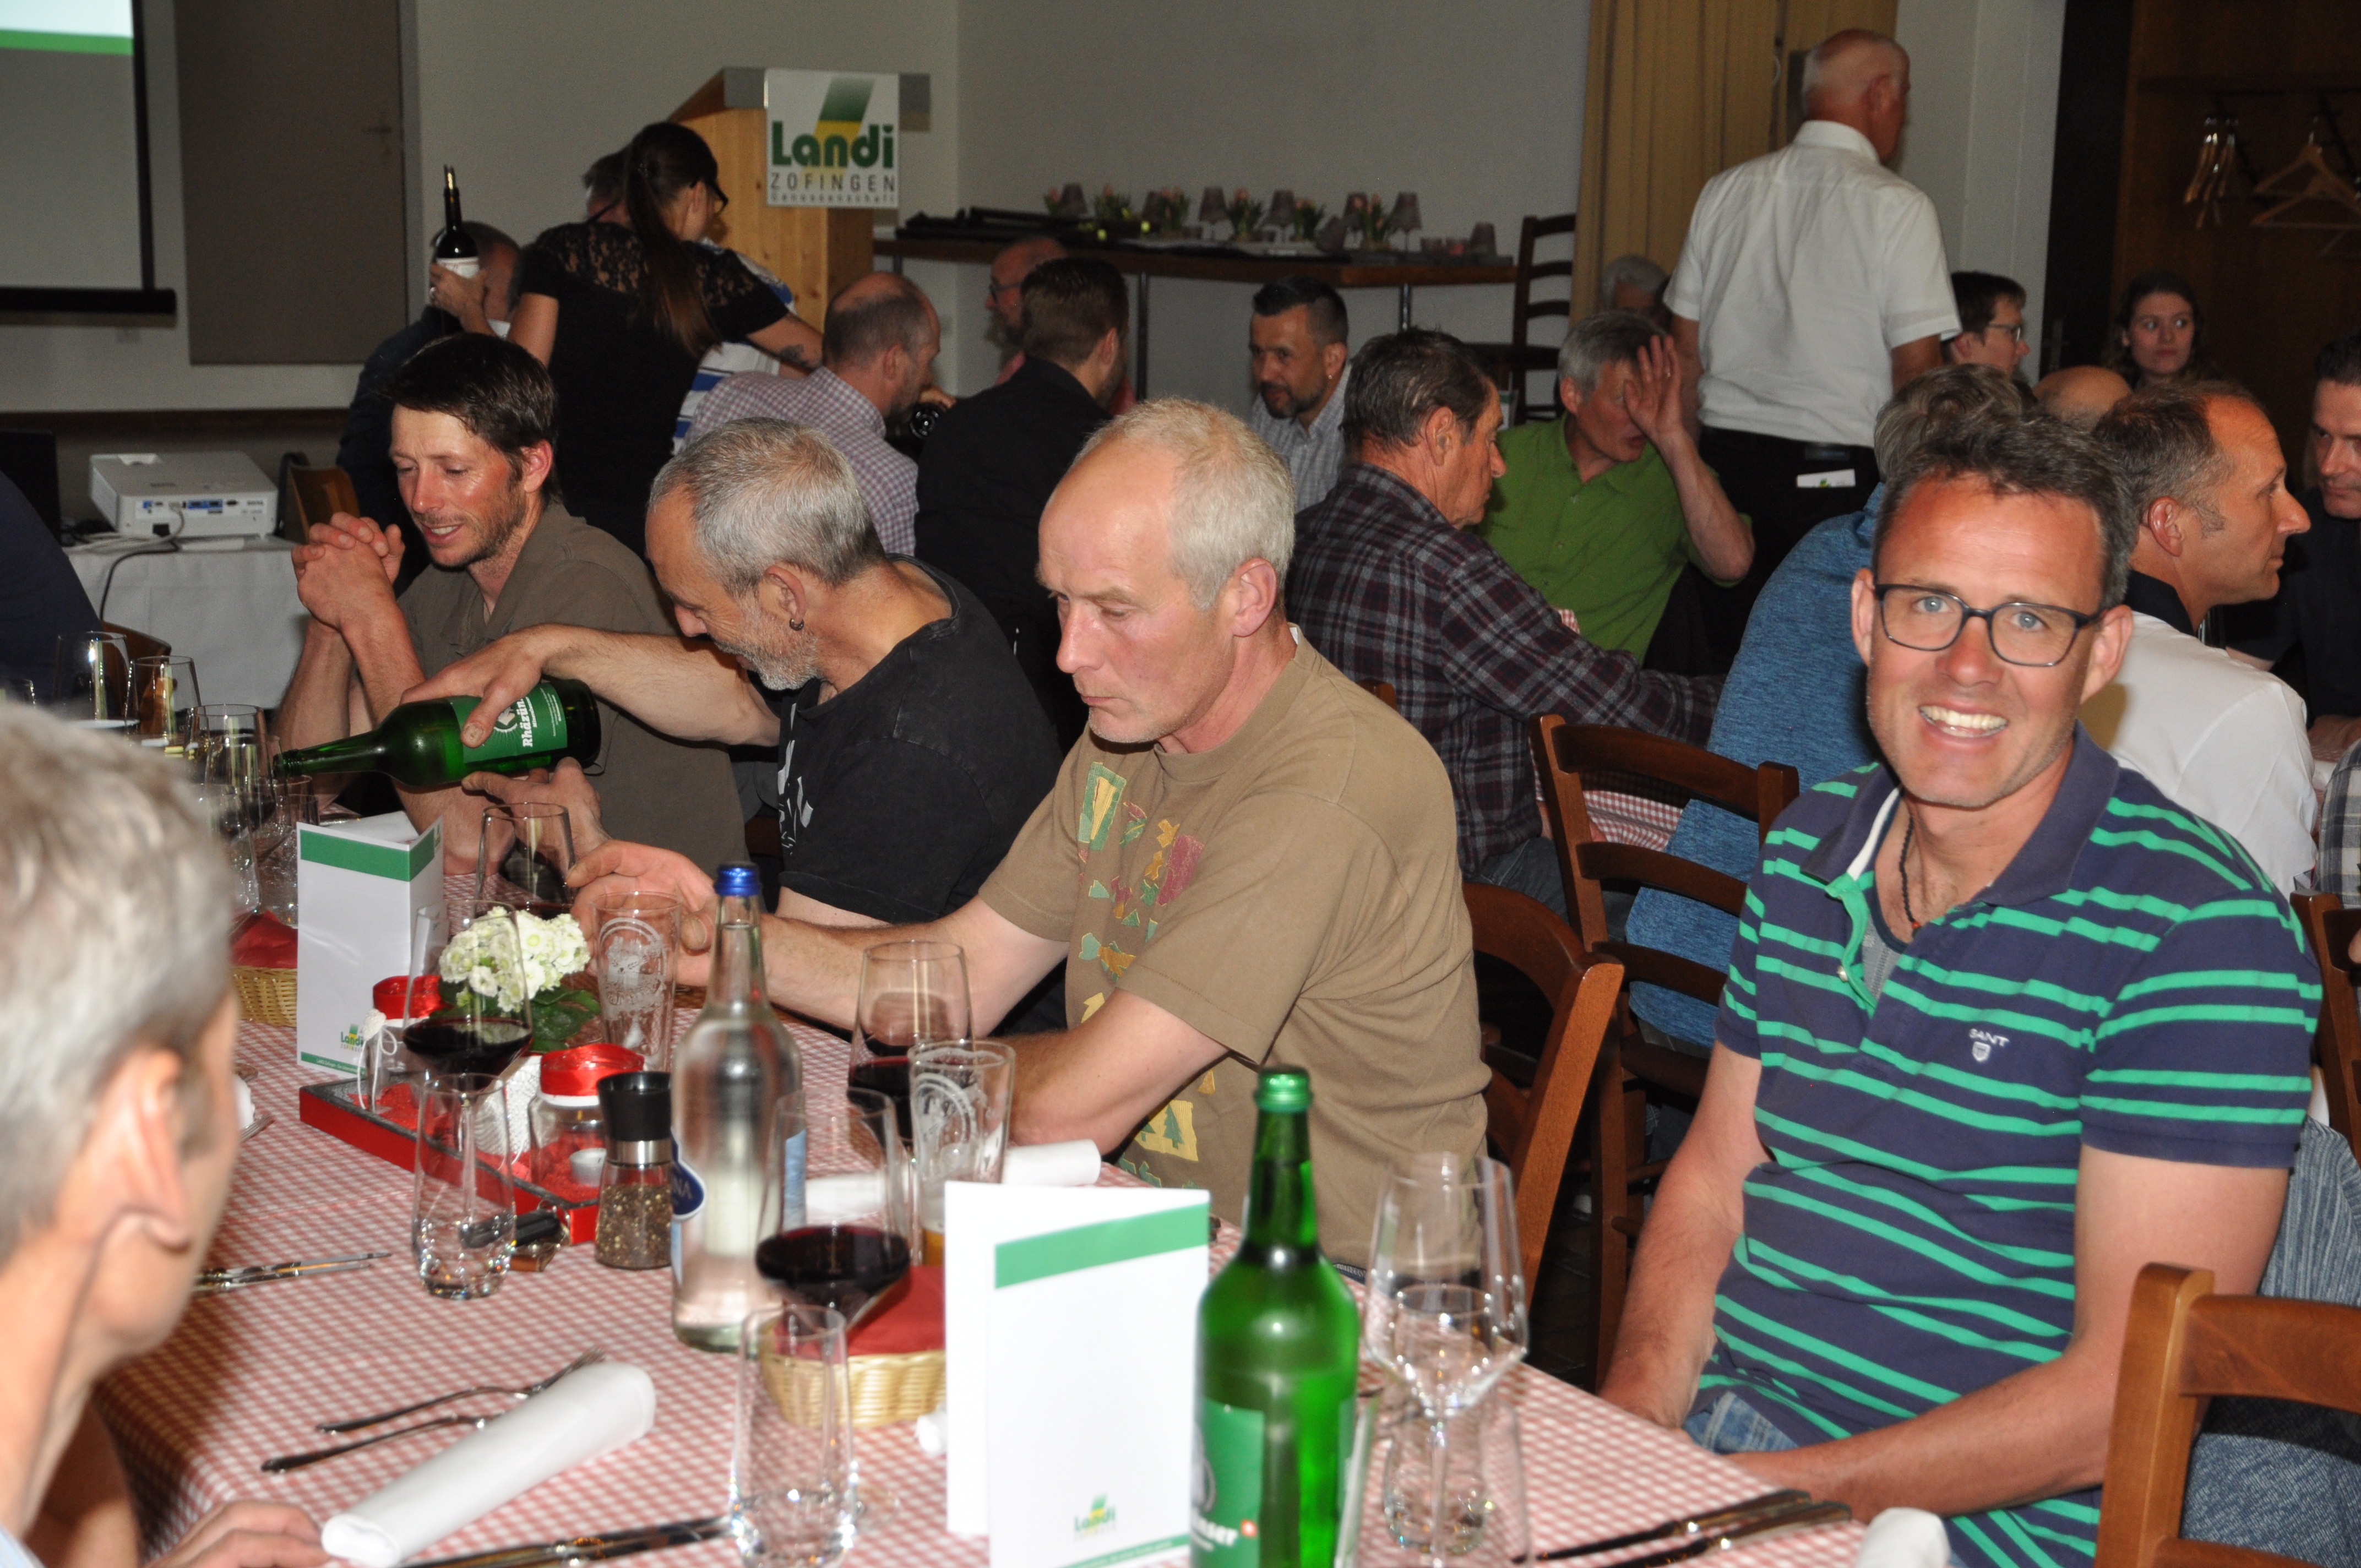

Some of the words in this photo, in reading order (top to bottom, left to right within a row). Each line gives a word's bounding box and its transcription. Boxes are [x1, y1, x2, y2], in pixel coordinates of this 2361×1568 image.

[771, 121, 894, 168] Landi
[770, 172, 895, 192] ZOFINGEN
[516, 698, 533, 748] Rhäzün
[341, 1031, 363, 1047] Landi
[1074, 1505, 1116, 1532] Landi
